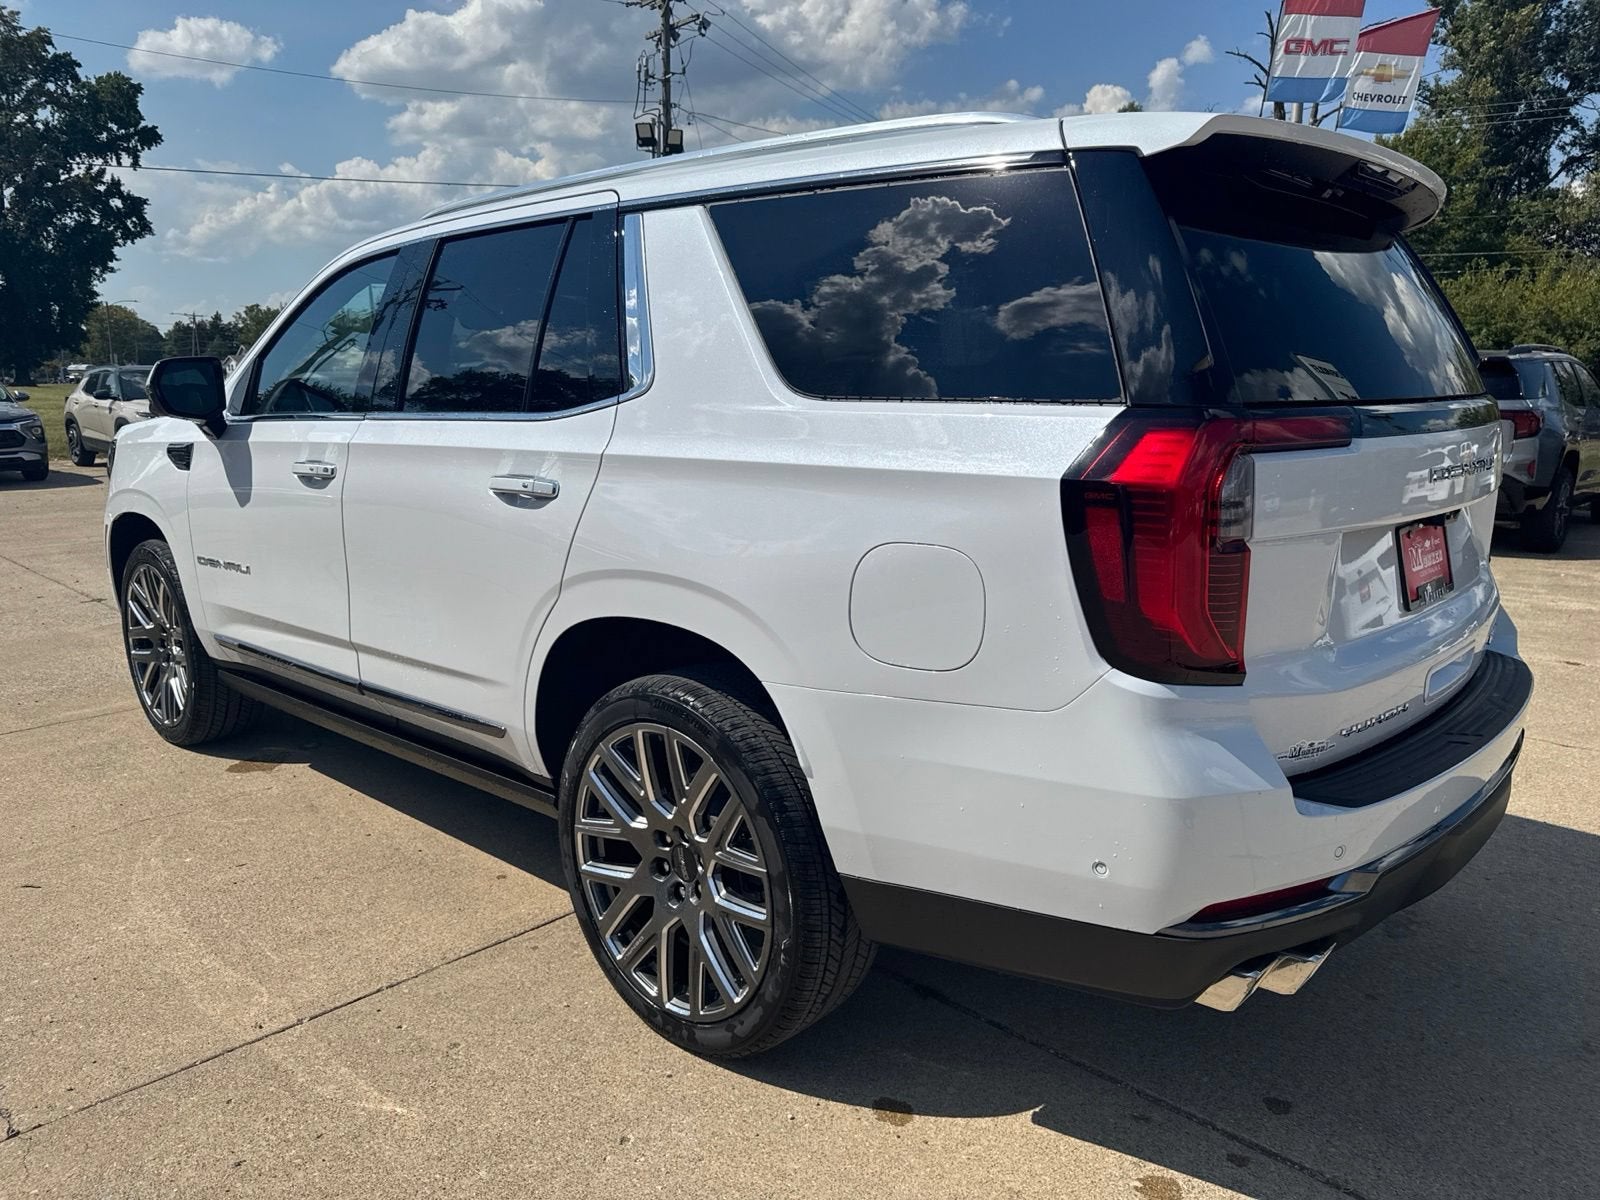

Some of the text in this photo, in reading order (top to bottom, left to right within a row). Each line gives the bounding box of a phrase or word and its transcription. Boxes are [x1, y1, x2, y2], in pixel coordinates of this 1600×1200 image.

[1283, 38, 1350, 56] GMC
[1352, 91, 1408, 105] CHEVROLET
[1084, 491, 1116, 501] GMC
[197, 556, 251, 575] DENALI
[1340, 703, 1409, 737] YUKON
